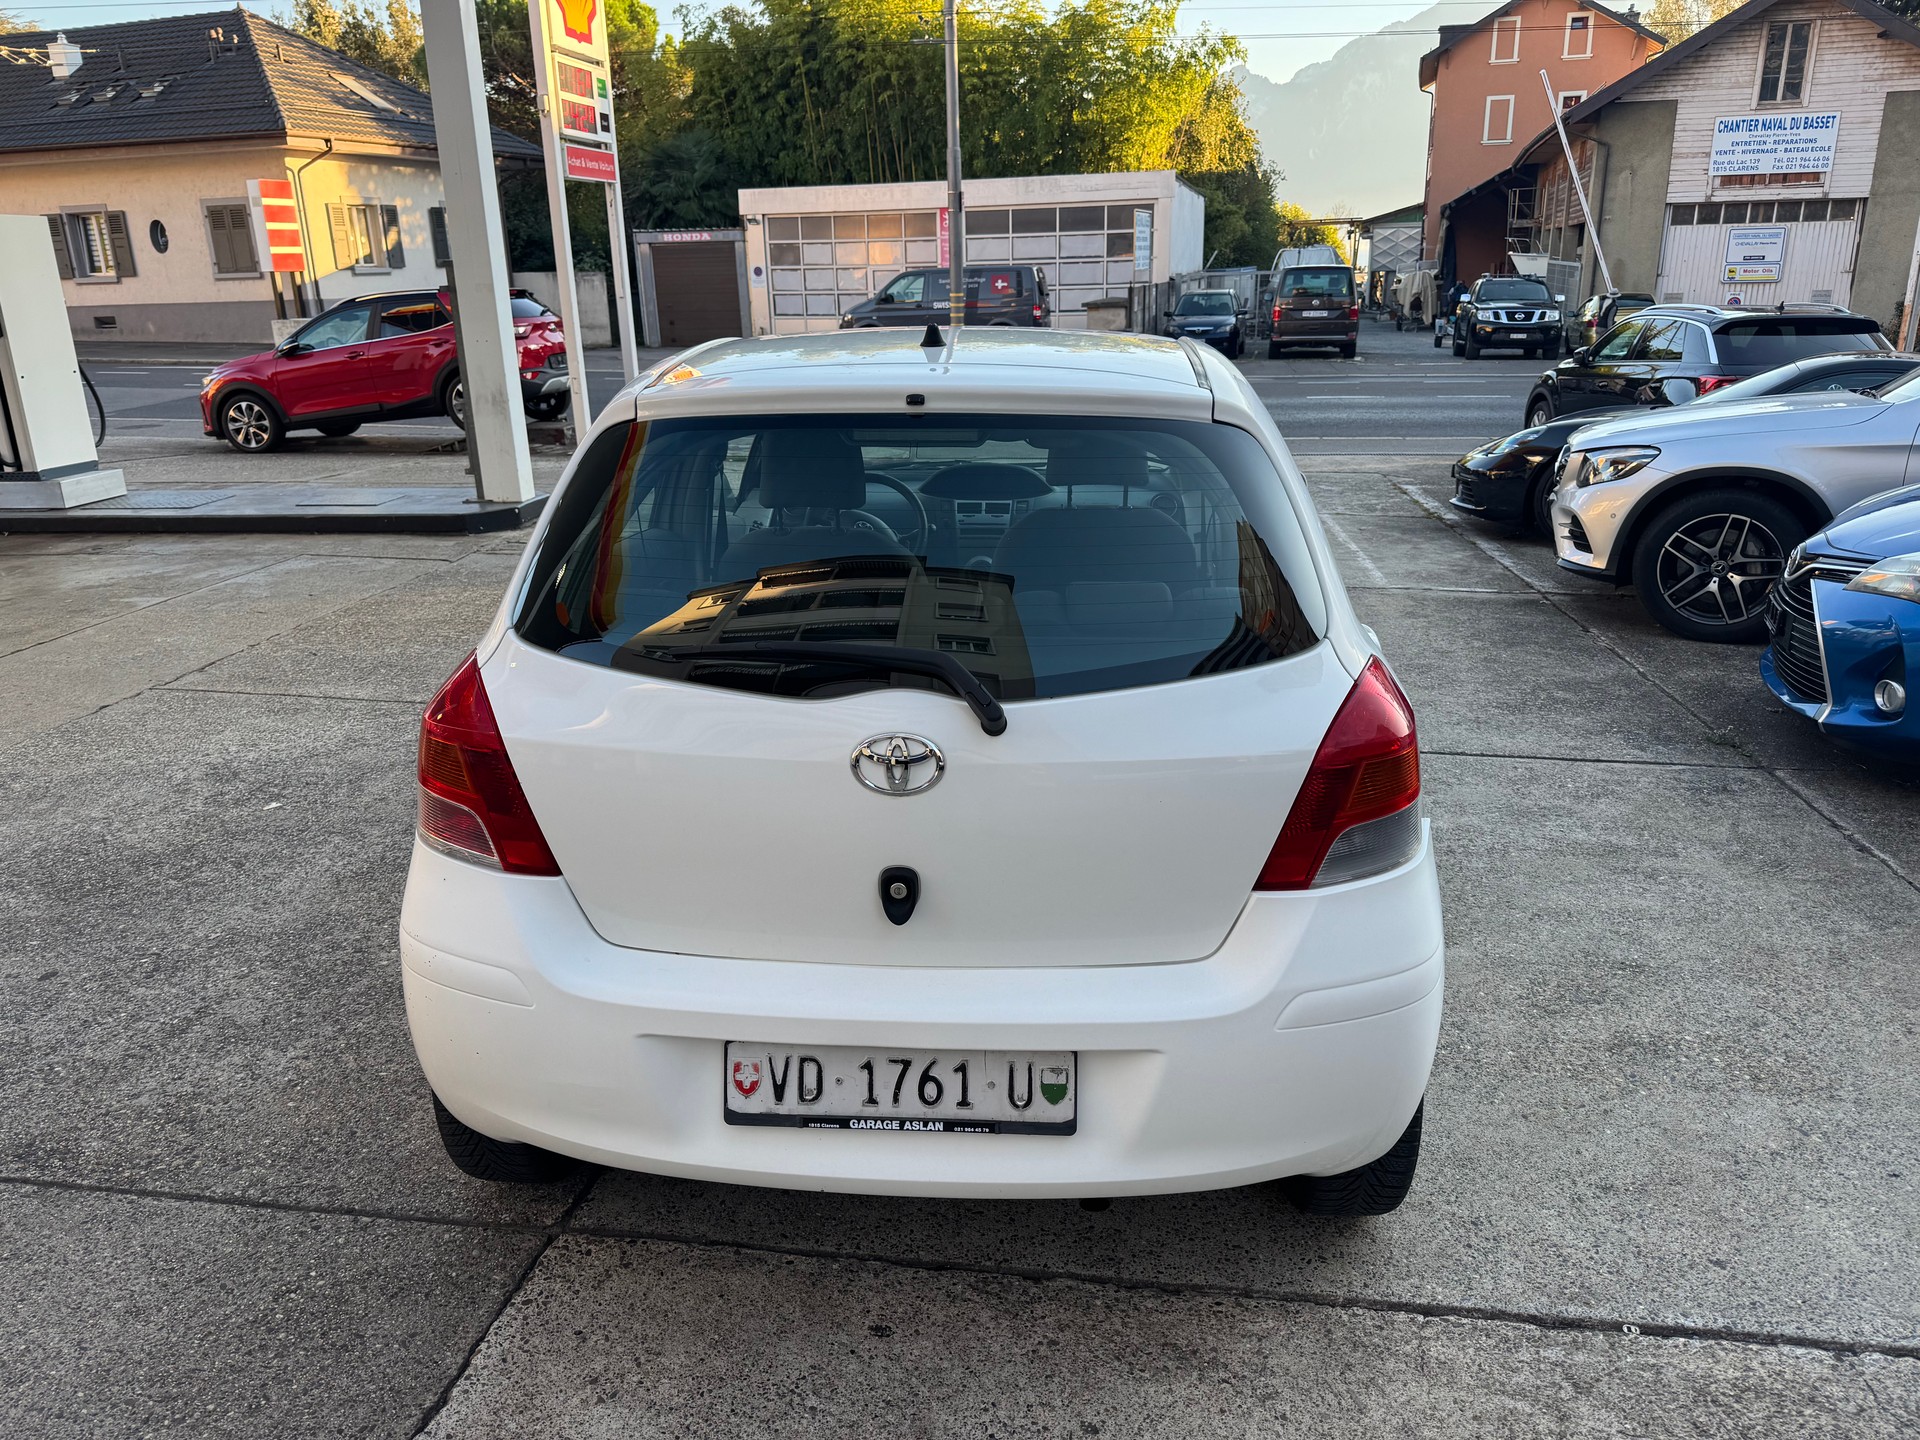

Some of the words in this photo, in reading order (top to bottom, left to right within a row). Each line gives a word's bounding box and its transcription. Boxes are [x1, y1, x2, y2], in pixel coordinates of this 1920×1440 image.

[1717, 118, 1760, 134] CHANTIER
[1760, 117, 1788, 132] NAVAL
[1789, 116, 1802, 131] DU
[1803, 115, 1837, 130] BASSET
[1731, 139, 1767, 147] ENTRETIEN
[1772, 138, 1818, 146] REPARATIONS
[1741, 147, 1778, 155] HIVERNAGE
[663, 232, 711, 241] HONDA
[767, 1053, 824, 1106] VD
[857, 1056, 974, 1110] 1761
[1007, 1060, 1035, 1110] U
[849, 1119, 900, 1130] GARAGE
[903, 1120, 944, 1131] ASLAN
